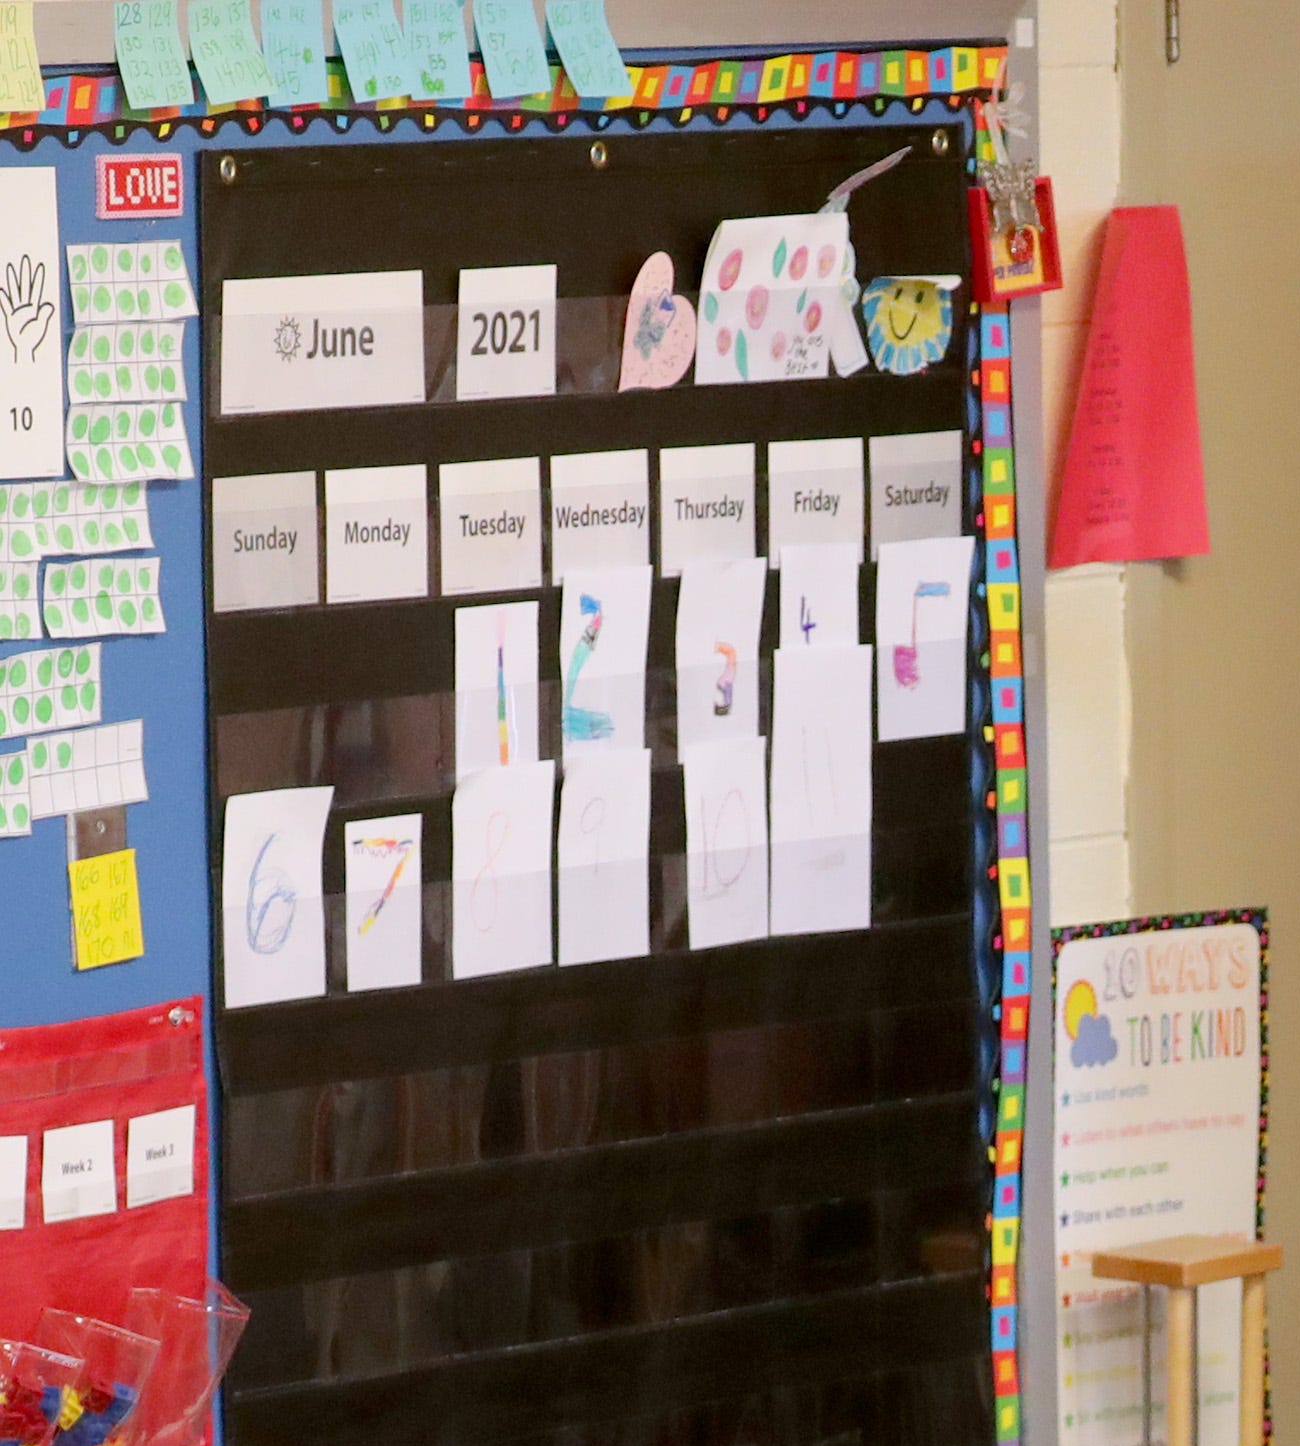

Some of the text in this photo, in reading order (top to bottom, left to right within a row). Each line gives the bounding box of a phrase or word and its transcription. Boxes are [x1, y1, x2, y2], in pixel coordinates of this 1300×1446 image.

[116, 3, 142, 28] 128
[107, 166, 178, 206] LOVE
[306, 318, 375, 359] June
[470, 309, 541, 356] 2021
[10, 408, 33, 432] 10
[674, 496, 745, 522] Thursday
[793, 490, 840, 513] Friday
[884, 483, 950, 507] Saturday
[344, 518, 411, 547] Monday
[459, 510, 527, 539] Tuesday
[555, 502, 647, 529] Wednesday
[233, 526, 298, 554] Sunday
[800, 594, 817, 645] 4
[562, 593, 614, 741] 2
[714, 641, 736, 716] 3
[700, 787, 752, 893] 10
[352, 837, 414, 936] 7
[469, 810, 510, 932] 8
[246, 832, 297, 955] 6
[1146, 938, 1249, 995] WAYS
[1126, 1006, 1246, 1067] TO BE KIND
[61, 1160, 93, 1176] Week 2
[146, 1144, 174, 1161] Week 3
